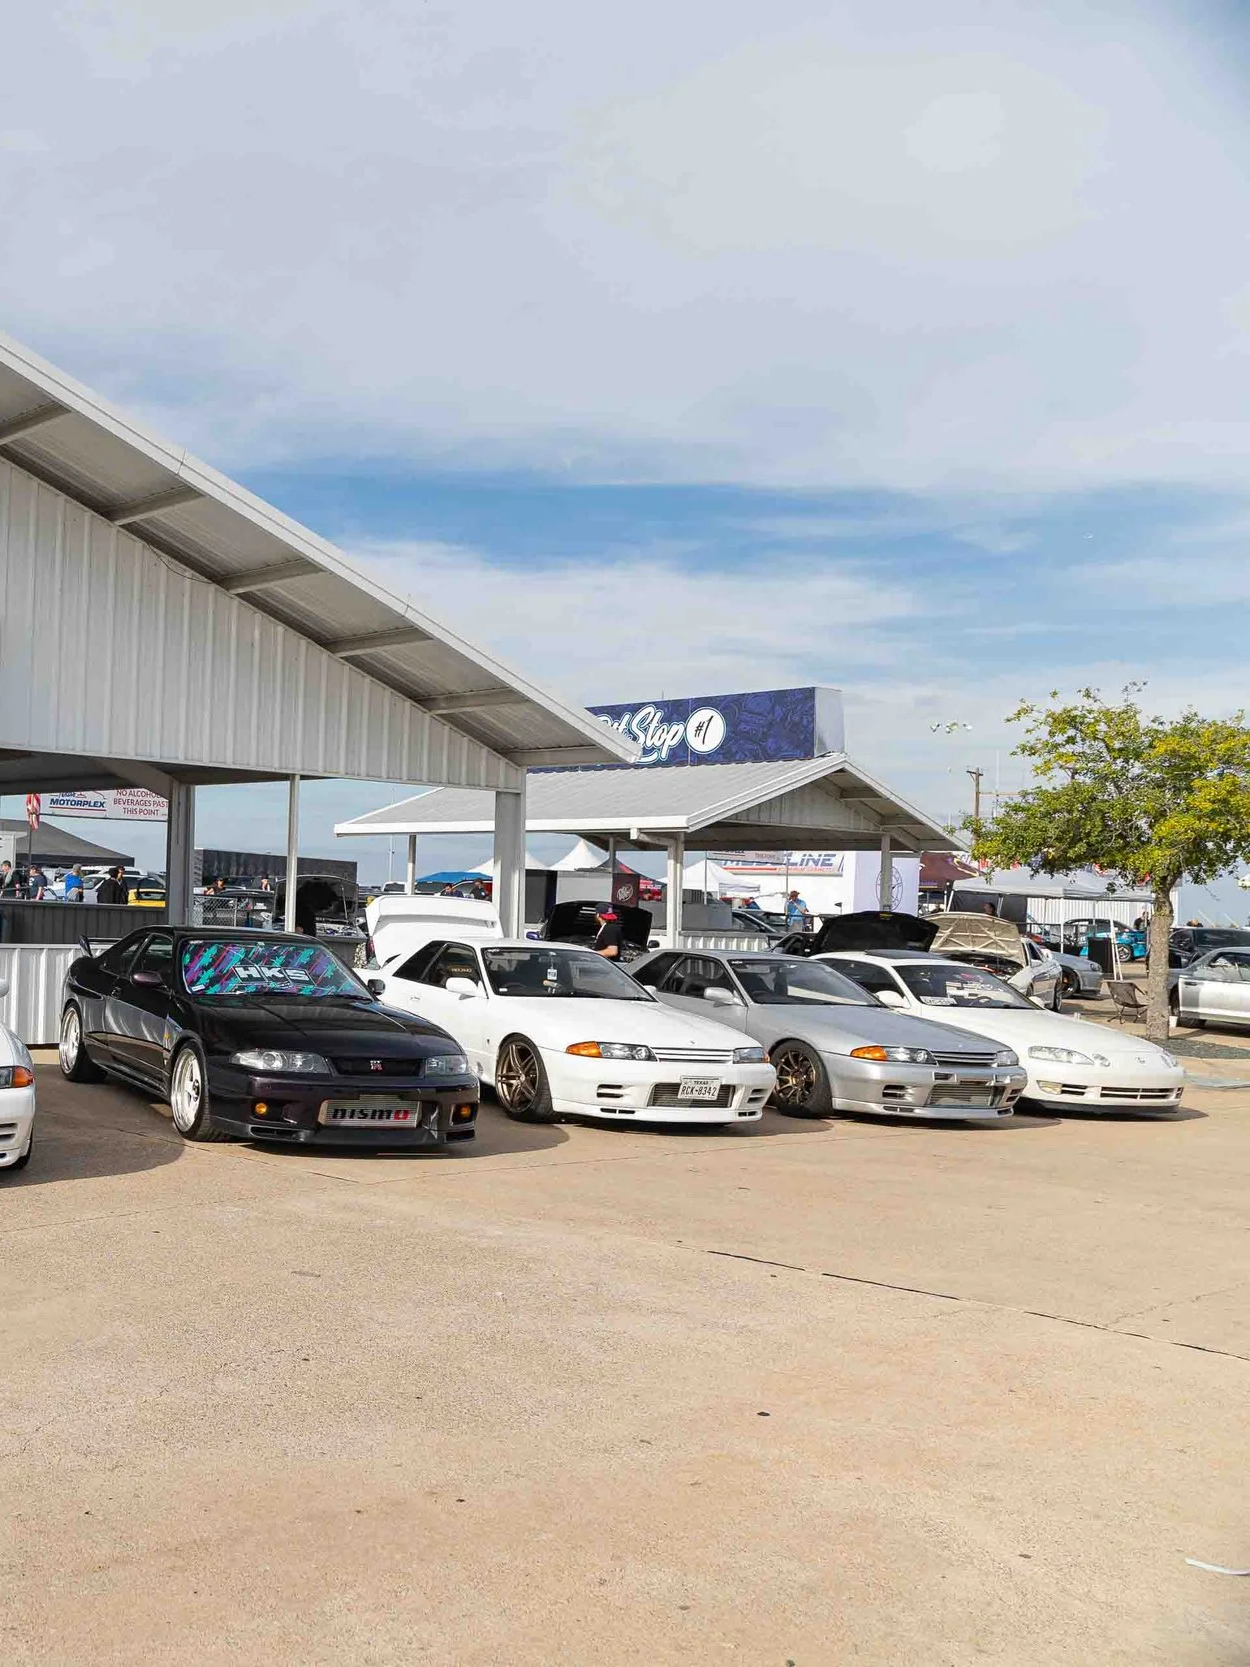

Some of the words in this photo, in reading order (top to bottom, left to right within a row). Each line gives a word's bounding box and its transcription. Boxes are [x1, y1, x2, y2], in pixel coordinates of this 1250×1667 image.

[695, 715, 714, 745] #1
[49, 798, 106, 808] MOTORPLEX
[113, 798, 151, 806] BEVERAGES
[139, 808, 159, 816] POINT
[234, 966, 310, 981] HKS
